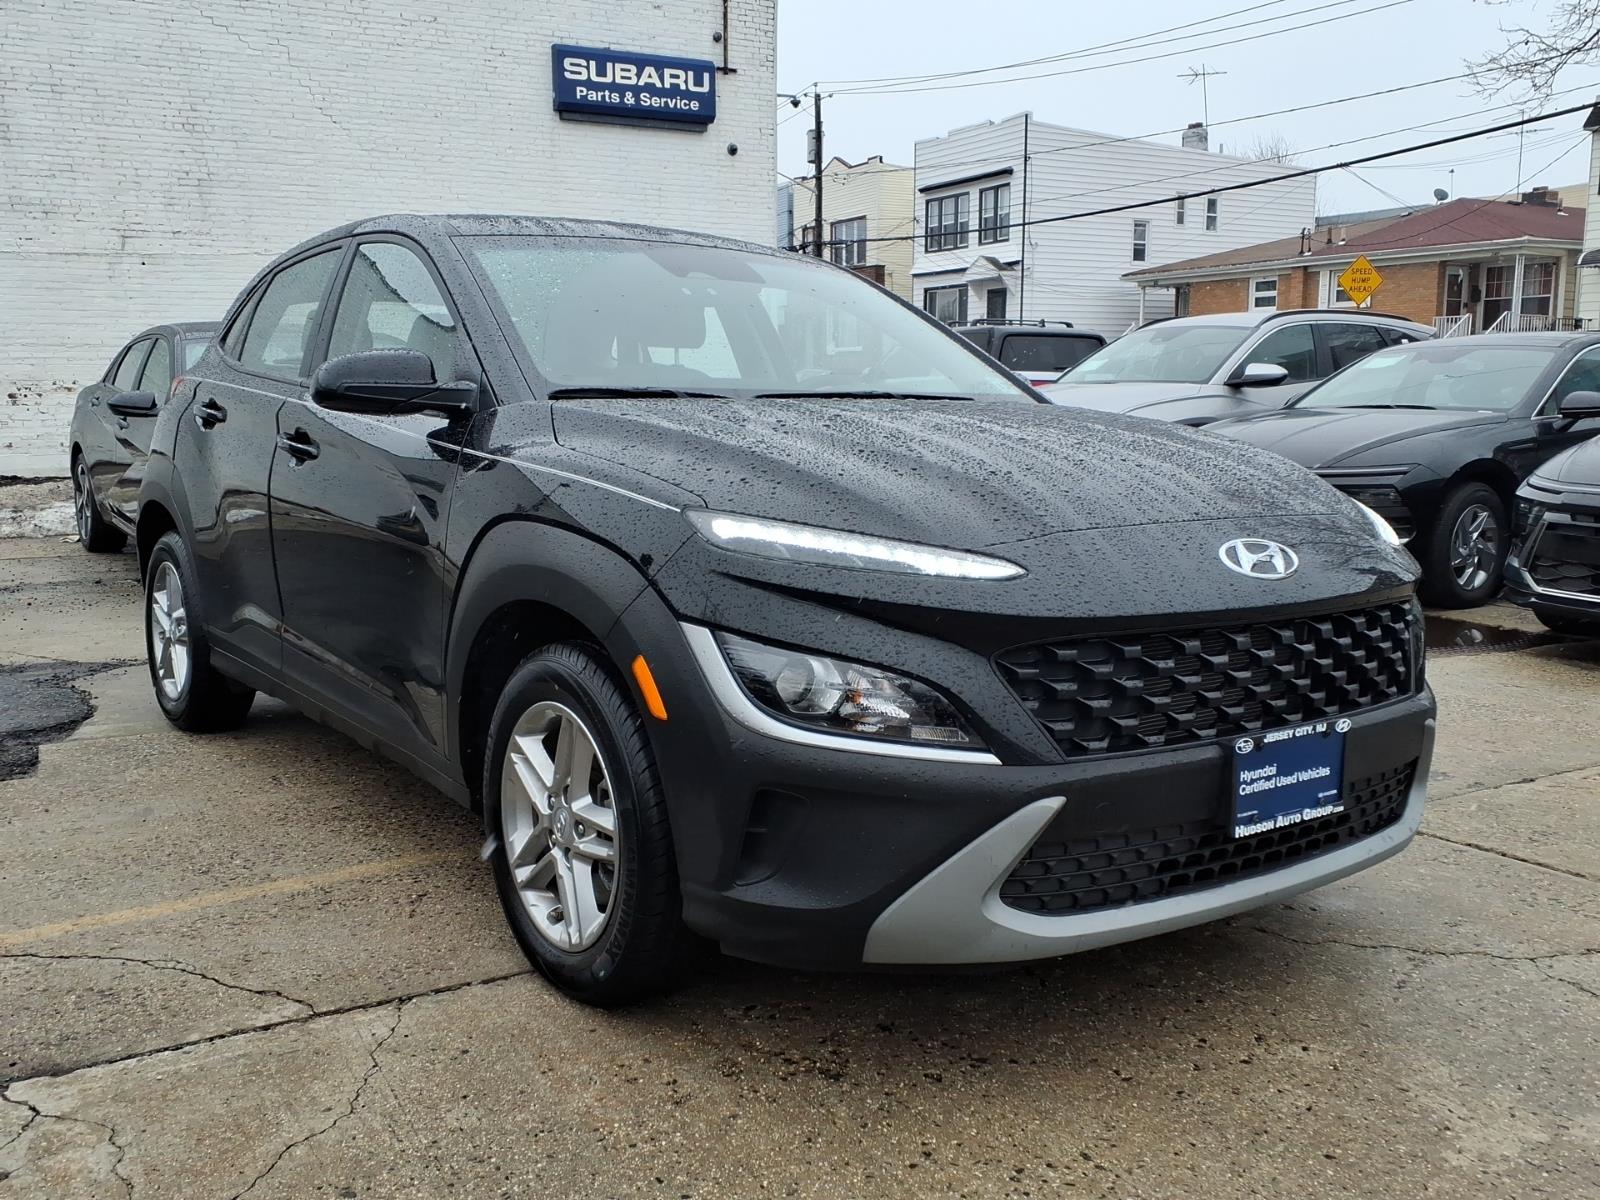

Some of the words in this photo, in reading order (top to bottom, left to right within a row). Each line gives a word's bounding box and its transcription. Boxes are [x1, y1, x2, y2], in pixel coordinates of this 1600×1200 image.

[563, 57, 710, 93] SUBARU
[576, 86, 620, 104] Parts
[624, 91, 636, 105] &
[640, 92, 700, 111] Service
[1263, 729, 1294, 743] JERSEY
[1315, 722, 1327, 732] NJ
[1239, 777, 1276, 795] Certified
[1276, 772, 1298, 787] Used
[1298, 766, 1331, 781] Vehicles
[1240, 763, 1277, 782] Hyundai
